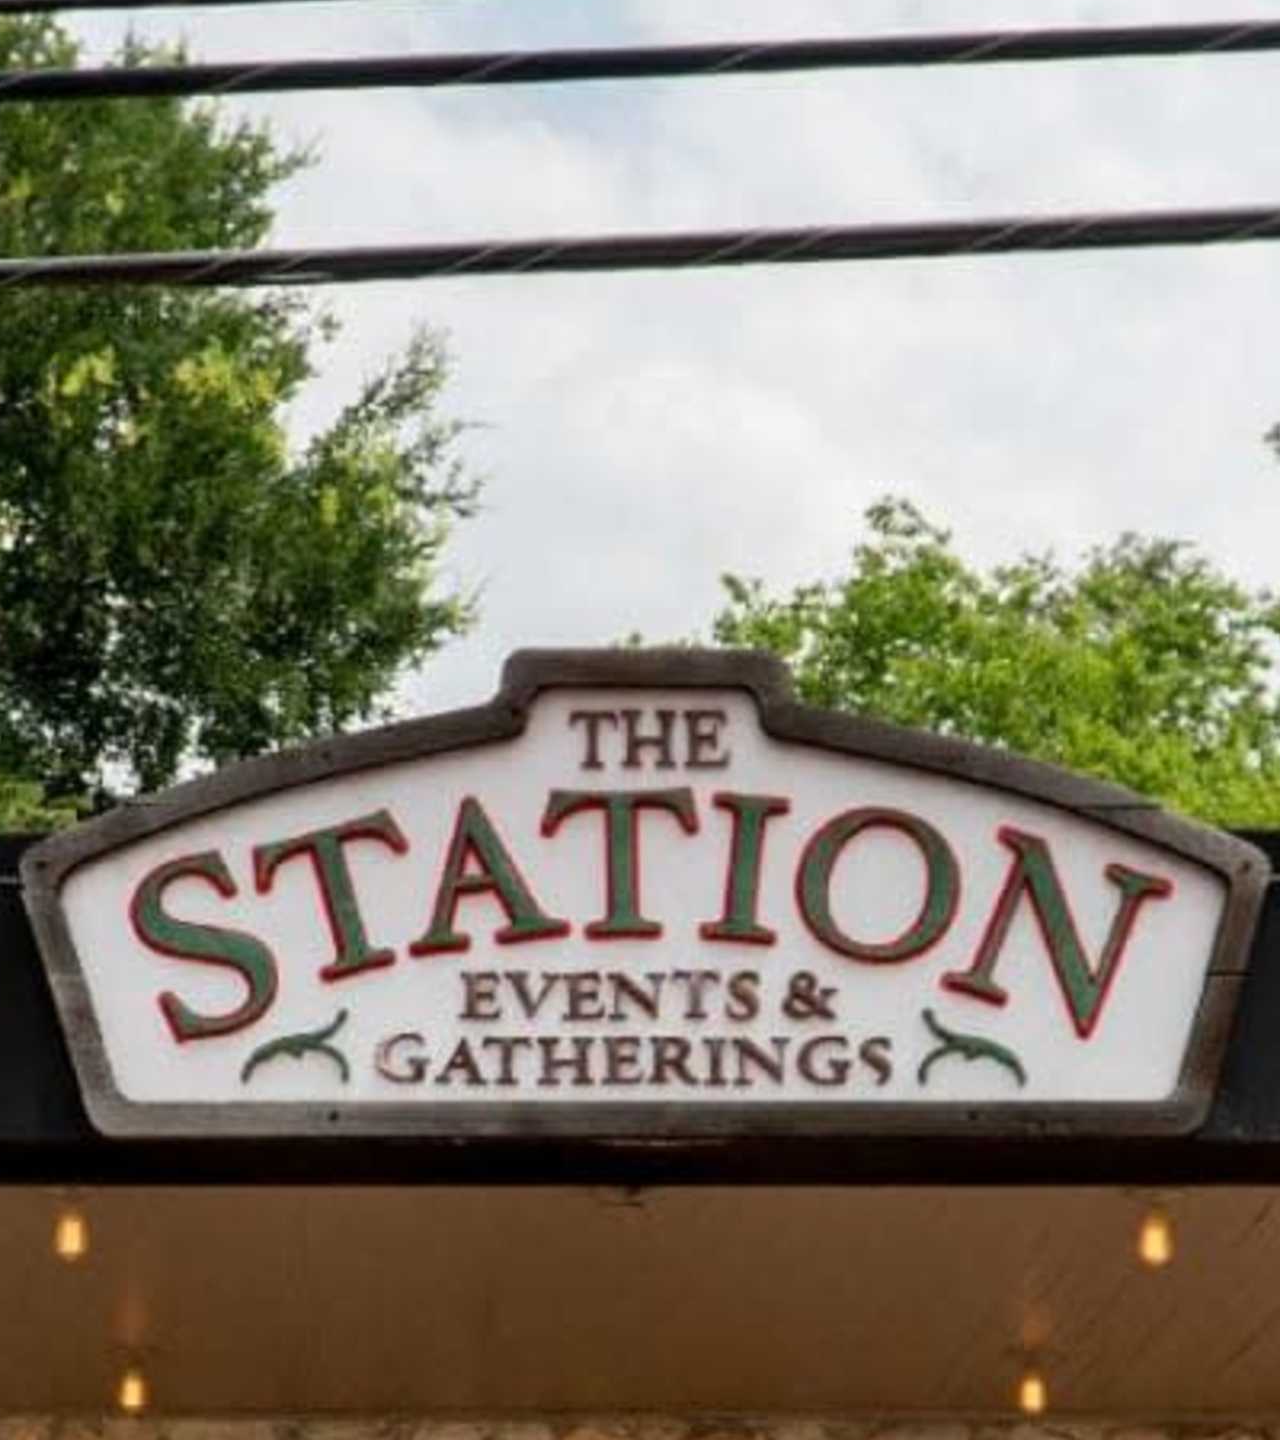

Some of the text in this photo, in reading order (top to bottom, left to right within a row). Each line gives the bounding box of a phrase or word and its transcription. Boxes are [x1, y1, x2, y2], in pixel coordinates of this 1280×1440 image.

[570, 708, 732, 772] THE
[128, 787, 1174, 1044] STATION
[458, 969, 836, 1023] EVENTS &
[375, 1033, 893, 1088] GATHERINGS
